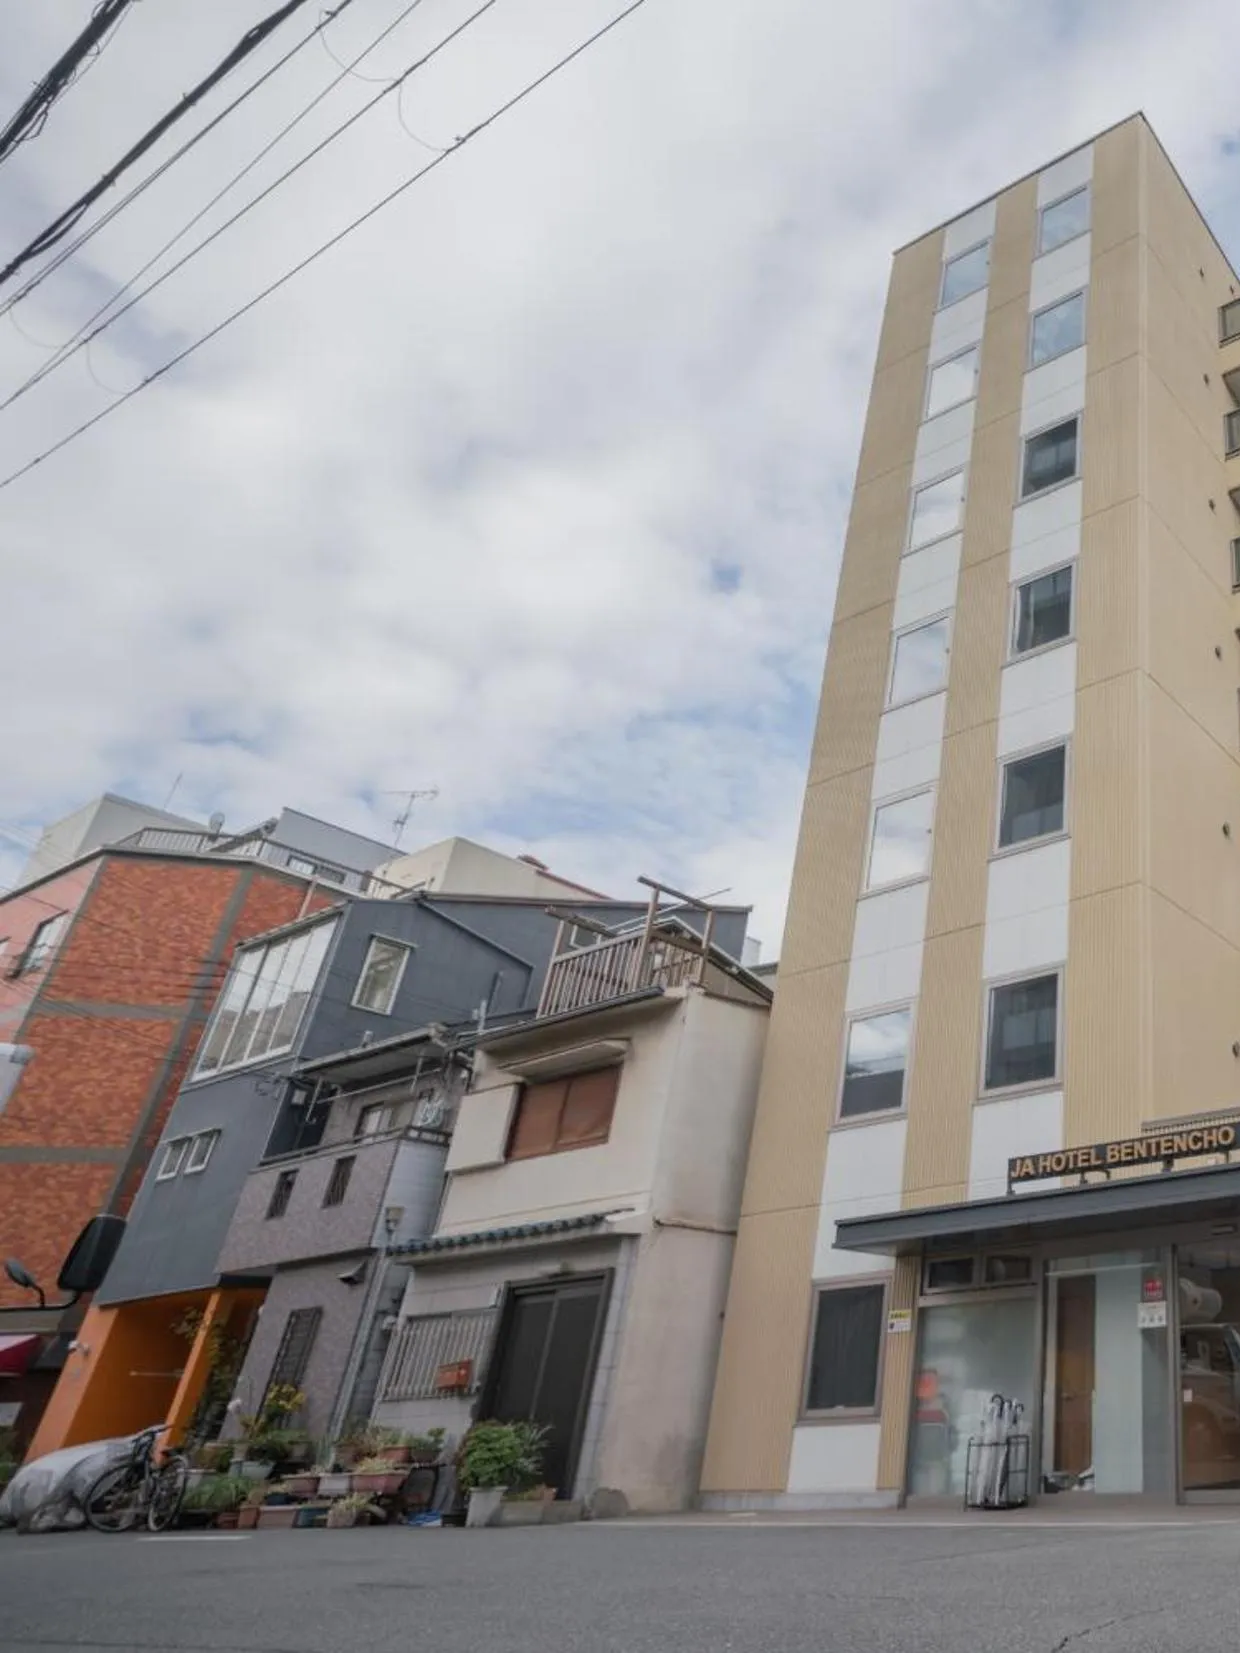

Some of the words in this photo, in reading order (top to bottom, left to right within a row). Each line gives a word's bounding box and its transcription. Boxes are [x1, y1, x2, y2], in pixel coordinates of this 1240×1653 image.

[1012, 1158, 1034, 1178] JA
[1038, 1148, 1101, 1173] HOTEL
[1106, 1125, 1235, 1163] BENTENCHO
